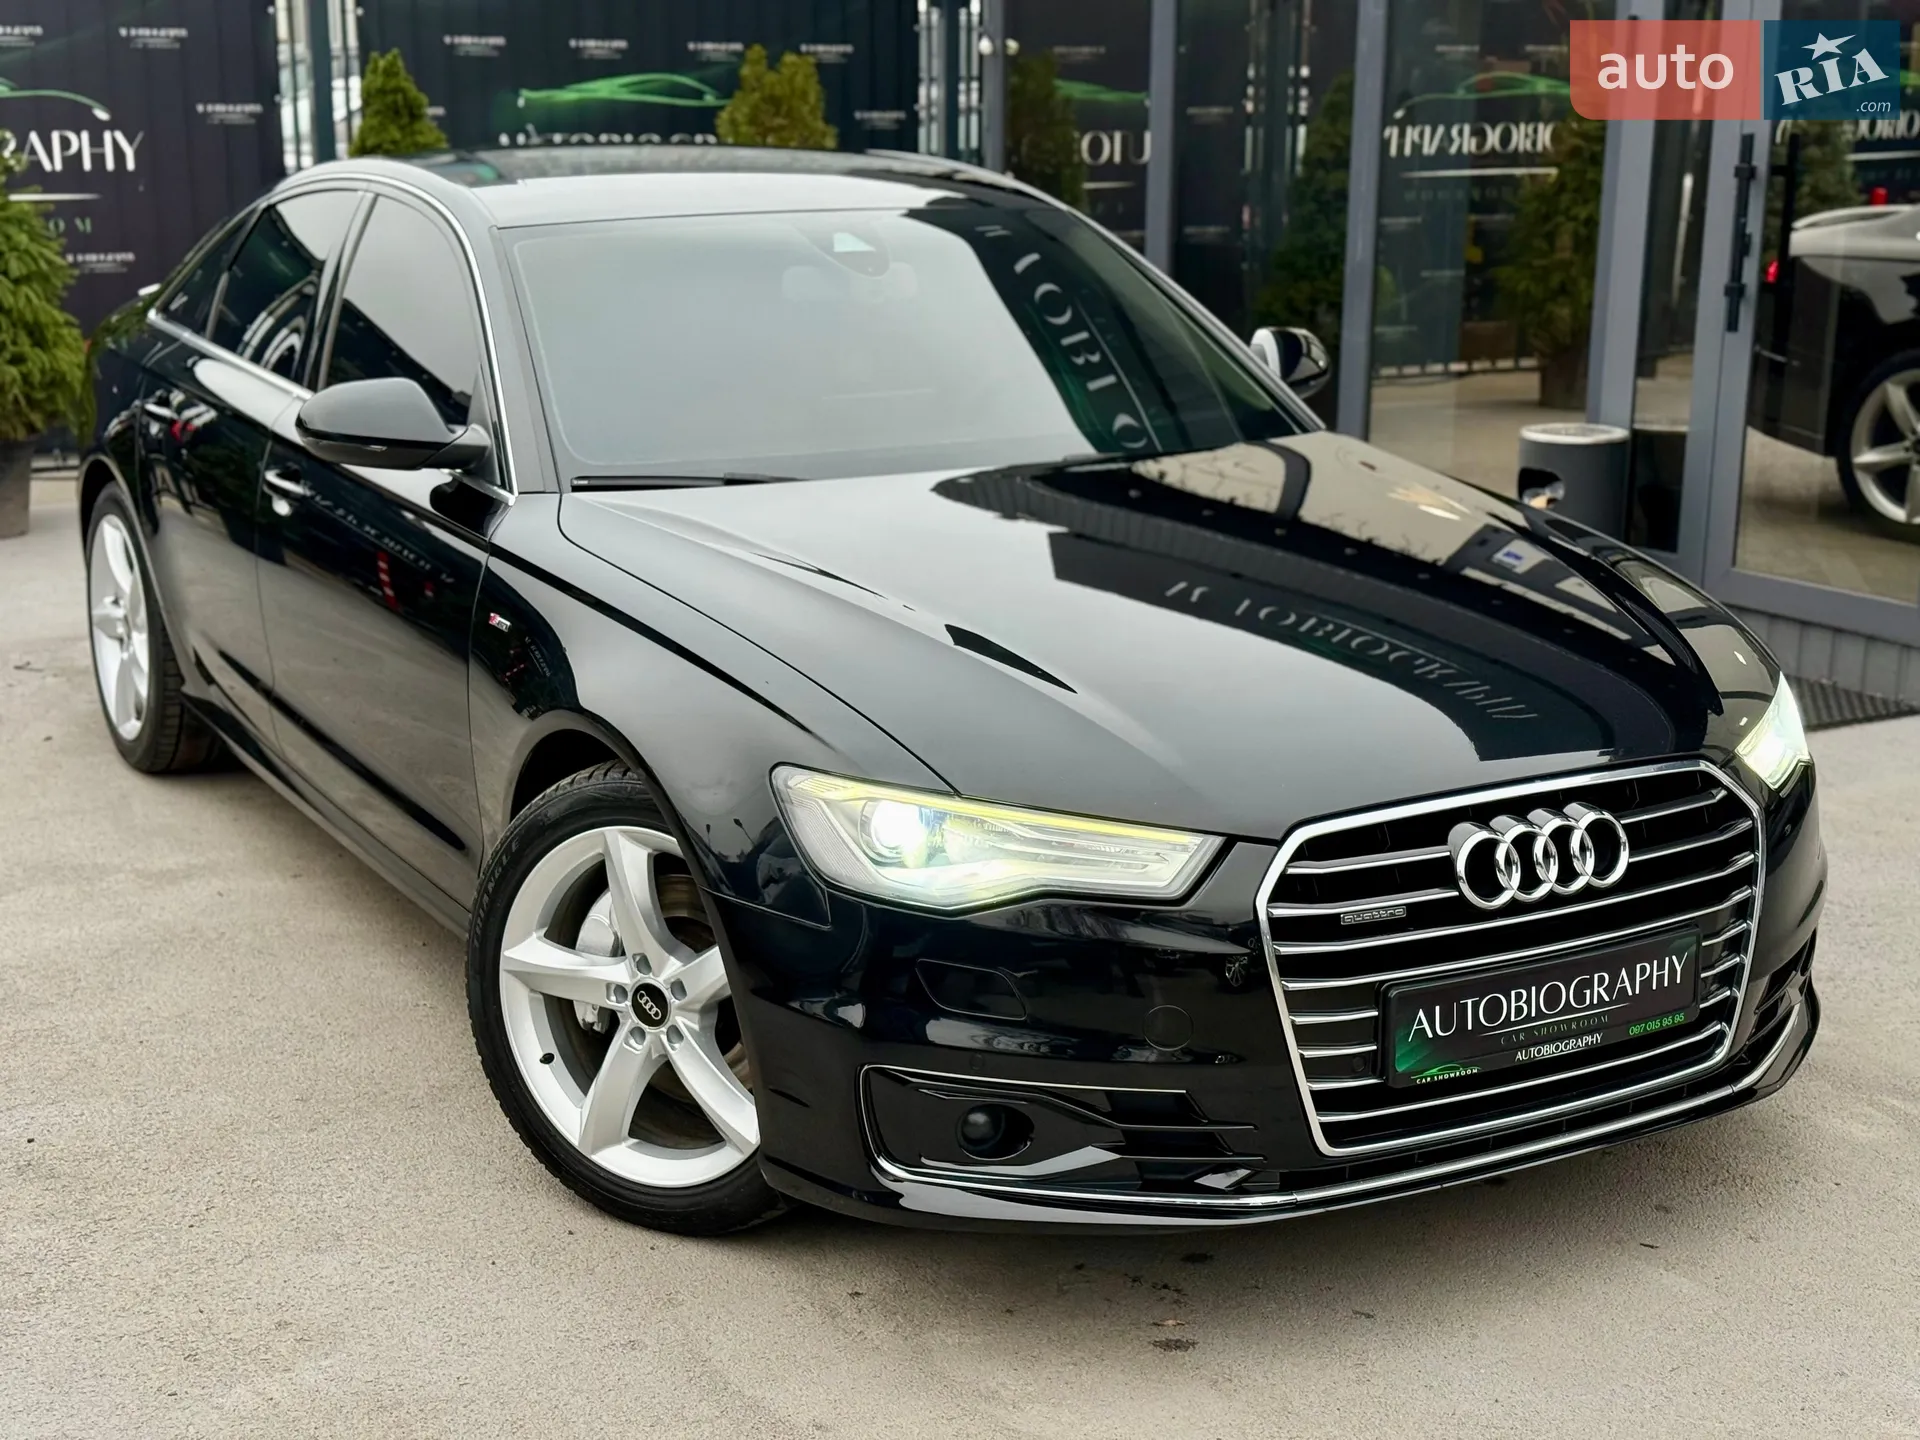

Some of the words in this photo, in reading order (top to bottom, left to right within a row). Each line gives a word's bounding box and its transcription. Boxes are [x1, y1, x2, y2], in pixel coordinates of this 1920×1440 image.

[1343, 907, 1405, 924] quattro
[1408, 951, 1688, 1042] AUTOBIOGRAPHY
[1500, 1031, 1525, 1045] CAR
[1533, 1014, 1609, 1036] SHOWROOM
[1629, 1023, 1645, 1036] 097
[1646, 1019, 1661, 1032] 015
[1662, 1016, 1673, 1027] 95
[1674, 1012, 1686, 1024] 95
[1514, 1032, 1604, 1062] AUTOBIOGRAPHY
[1416, 1076, 1432, 1084] CAR
[1434, 1068, 1479, 1082] SHOWROOM
